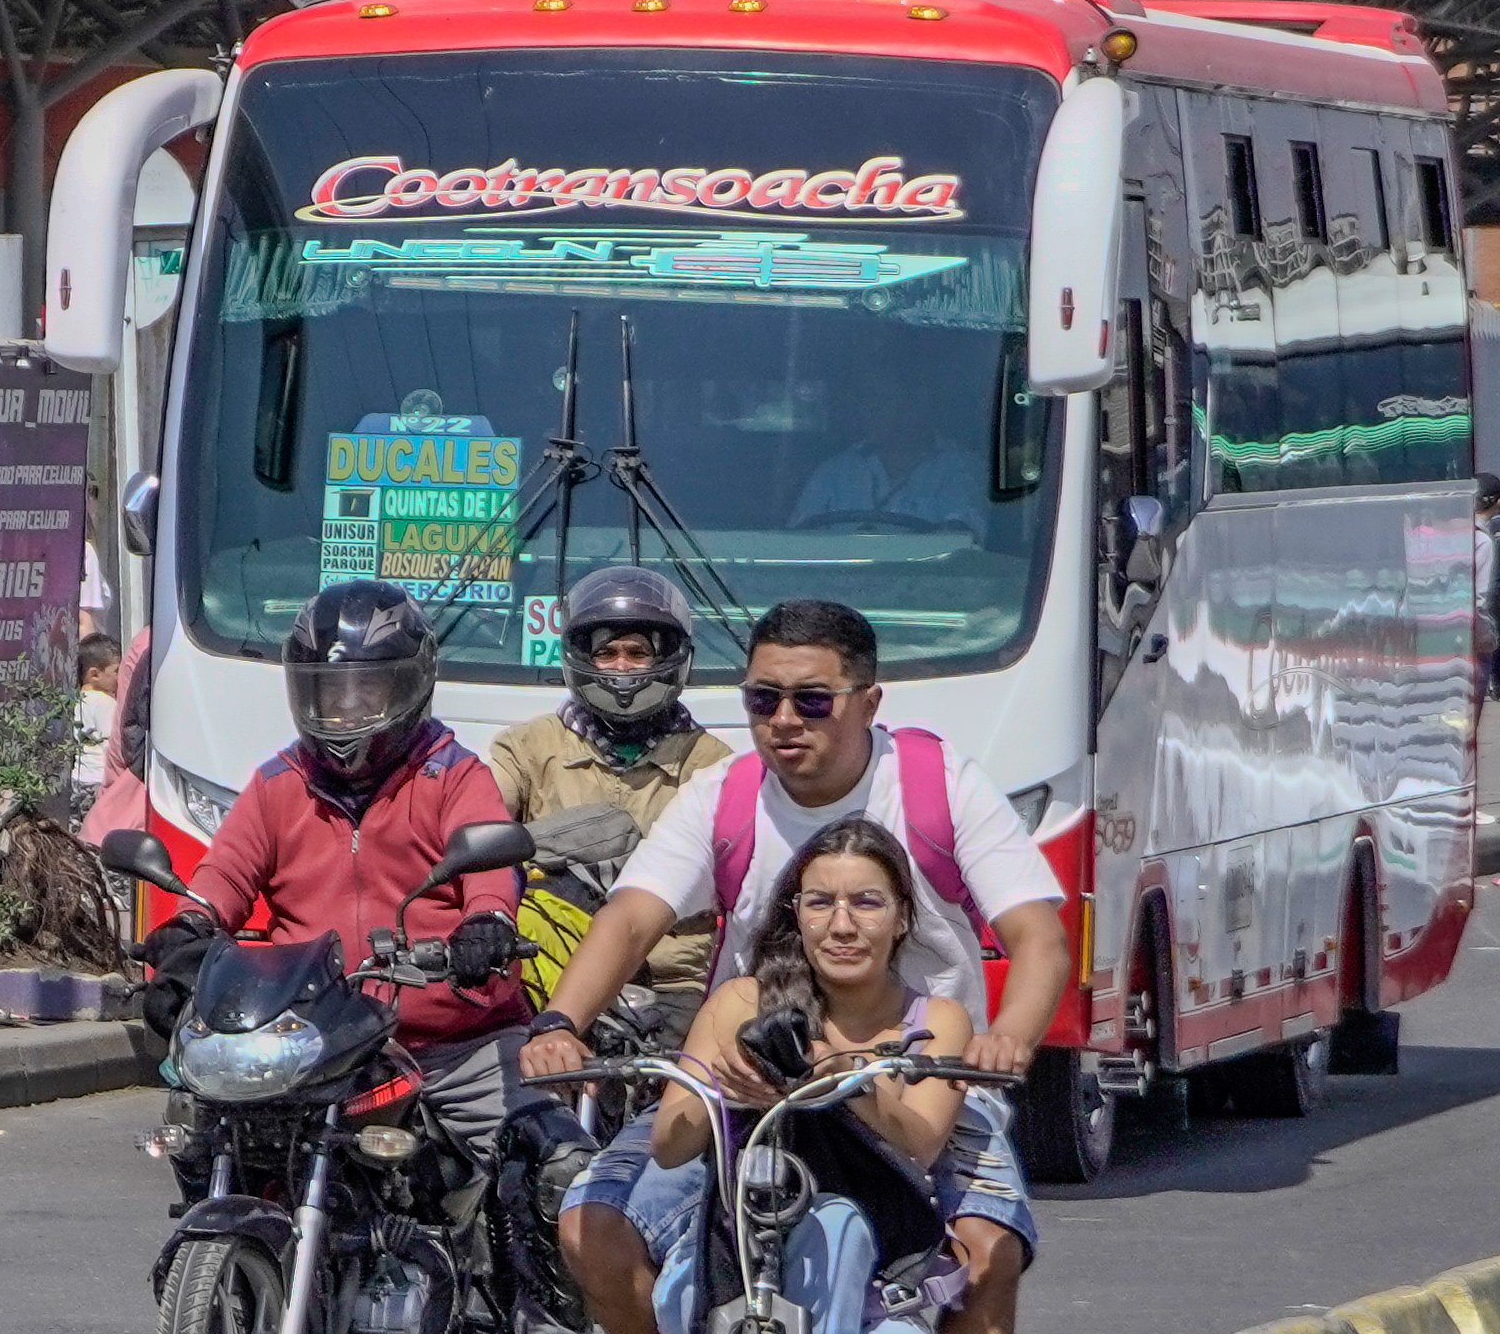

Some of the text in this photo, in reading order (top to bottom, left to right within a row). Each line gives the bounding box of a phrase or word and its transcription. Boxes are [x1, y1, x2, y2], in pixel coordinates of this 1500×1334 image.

[307, 156, 960, 215] Cootransoacha
[302, 238, 614, 261] LINCOLN
[420, 416, 472, 433] 22
[328, 436, 518, 486] DUCALES
[42, 465, 86, 485] CELULAR
[385, 489, 458, 518] QUINTAS
[464, 490, 486, 518] DE
[323, 522, 376, 541] UNISUR
[383, 521, 512, 553] LAGUNA
[323, 544, 375, 558] SOACHA
[322, 557, 376, 572] PARQUE
[380, 551, 450, 579] BOSQUES
